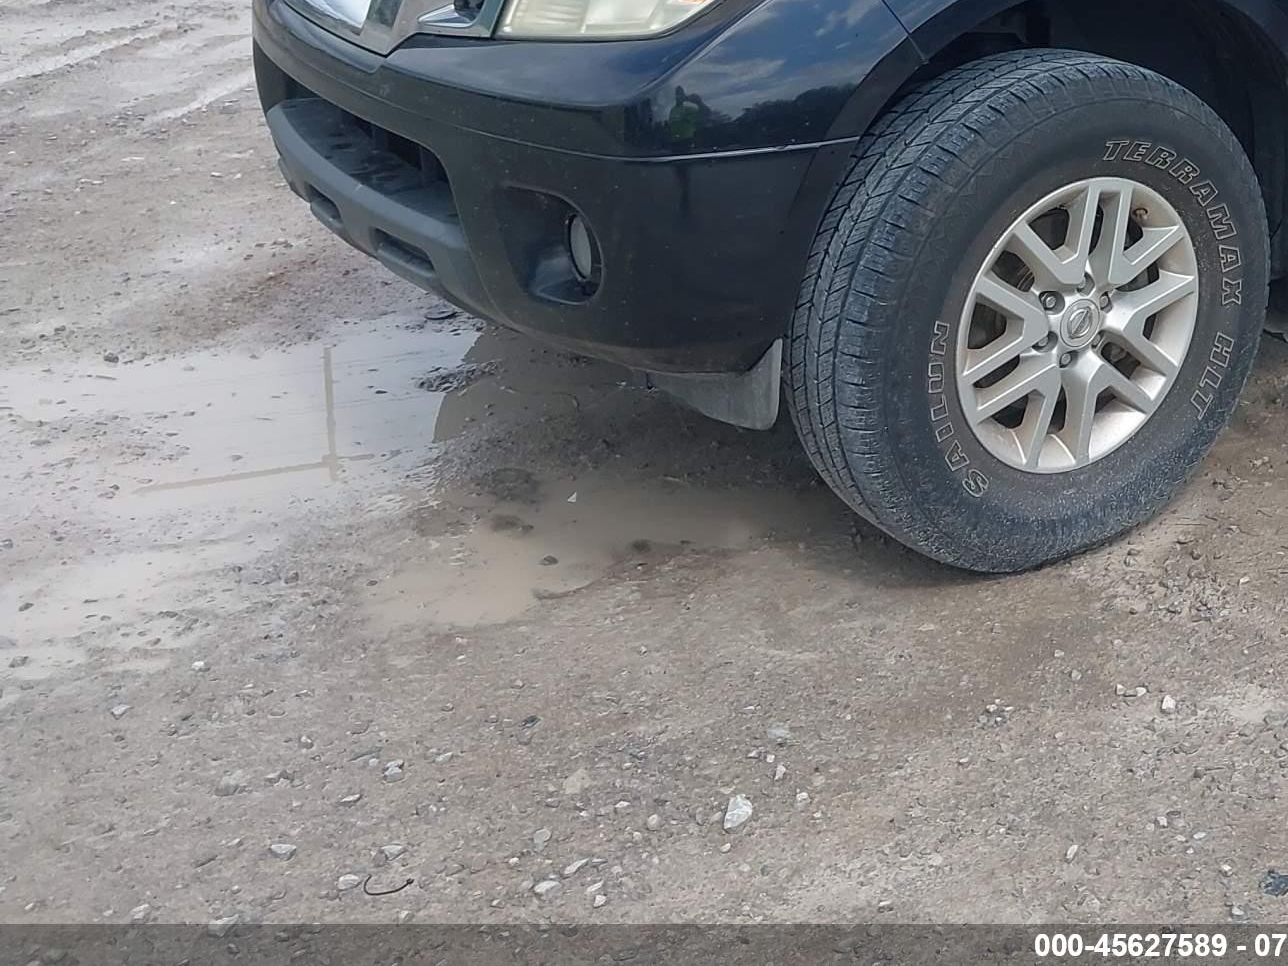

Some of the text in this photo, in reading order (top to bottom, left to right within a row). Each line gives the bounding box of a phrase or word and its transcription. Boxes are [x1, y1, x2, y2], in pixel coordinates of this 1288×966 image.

[1103, 139, 1242, 420] TERRAMAX HLT
[928, 320, 989, 498] SAILUN
